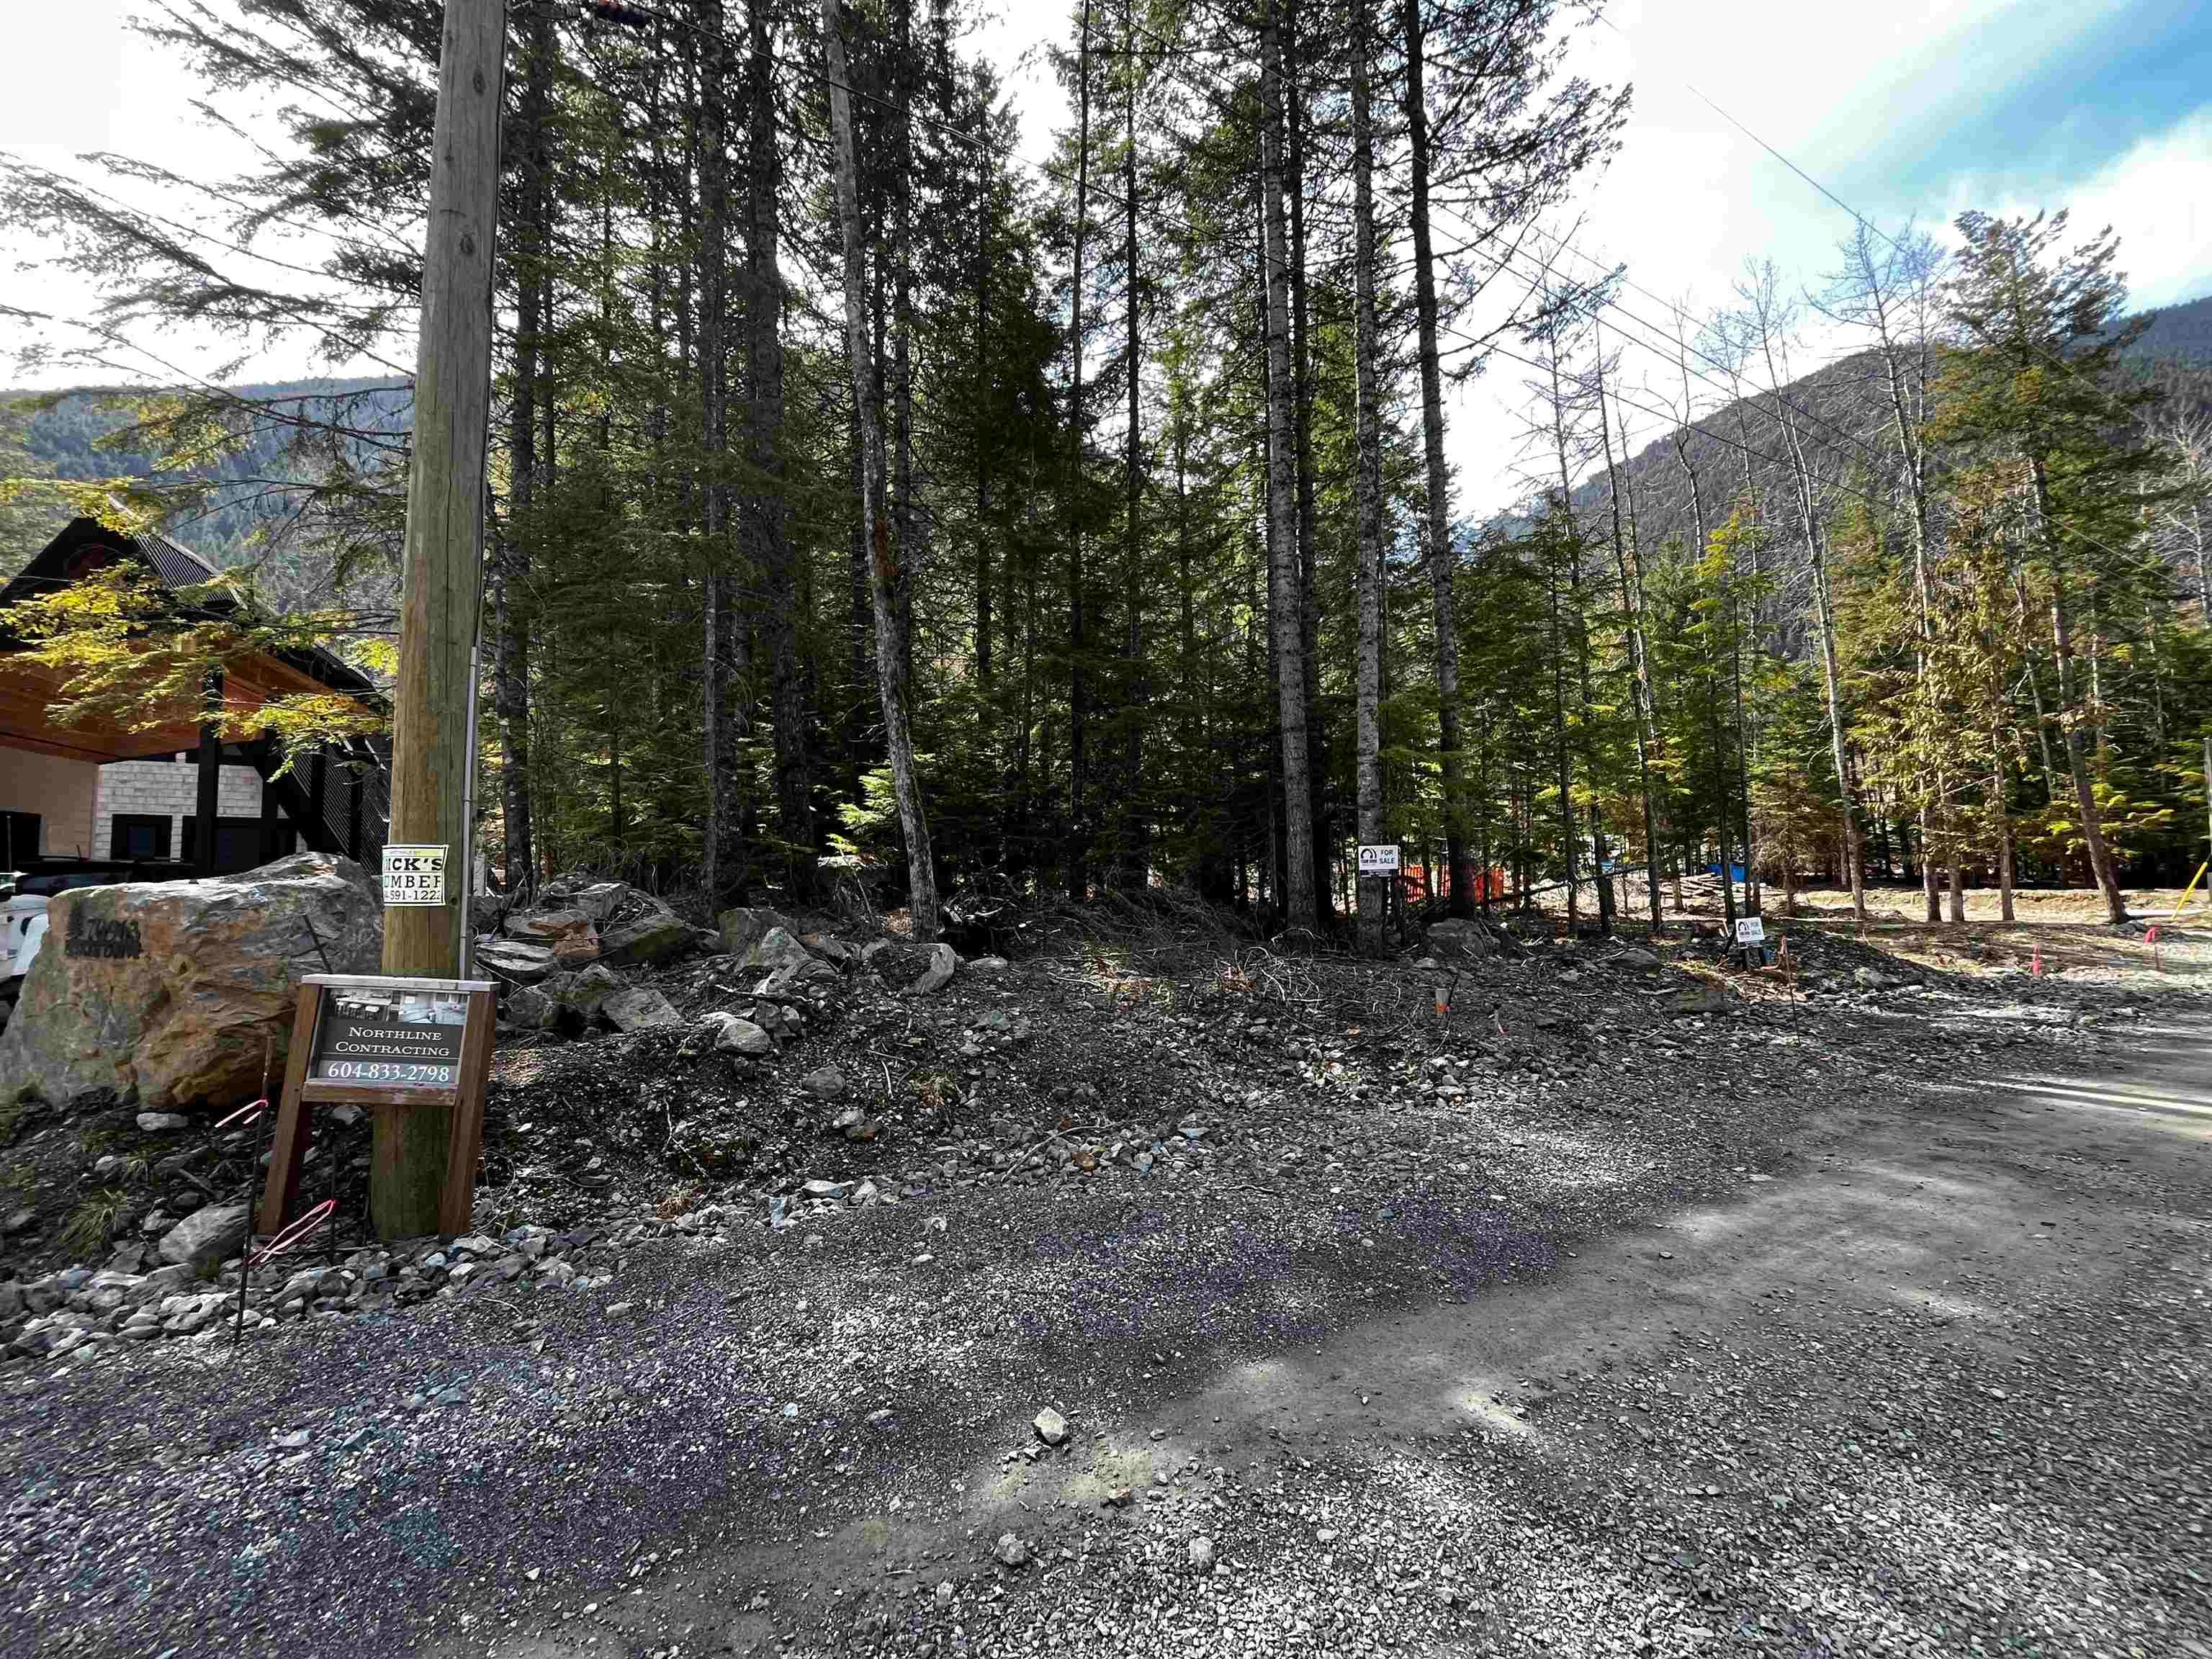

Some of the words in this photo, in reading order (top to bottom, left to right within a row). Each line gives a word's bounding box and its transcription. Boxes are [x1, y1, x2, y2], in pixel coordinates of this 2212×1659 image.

[384, 858, 442, 871] ICK'S
[349, 1027, 442, 1041] NORTHLINE
[336, 1041, 450, 1056] CONTRACTING
[328, 1062, 450, 1082] 604-833-2798
